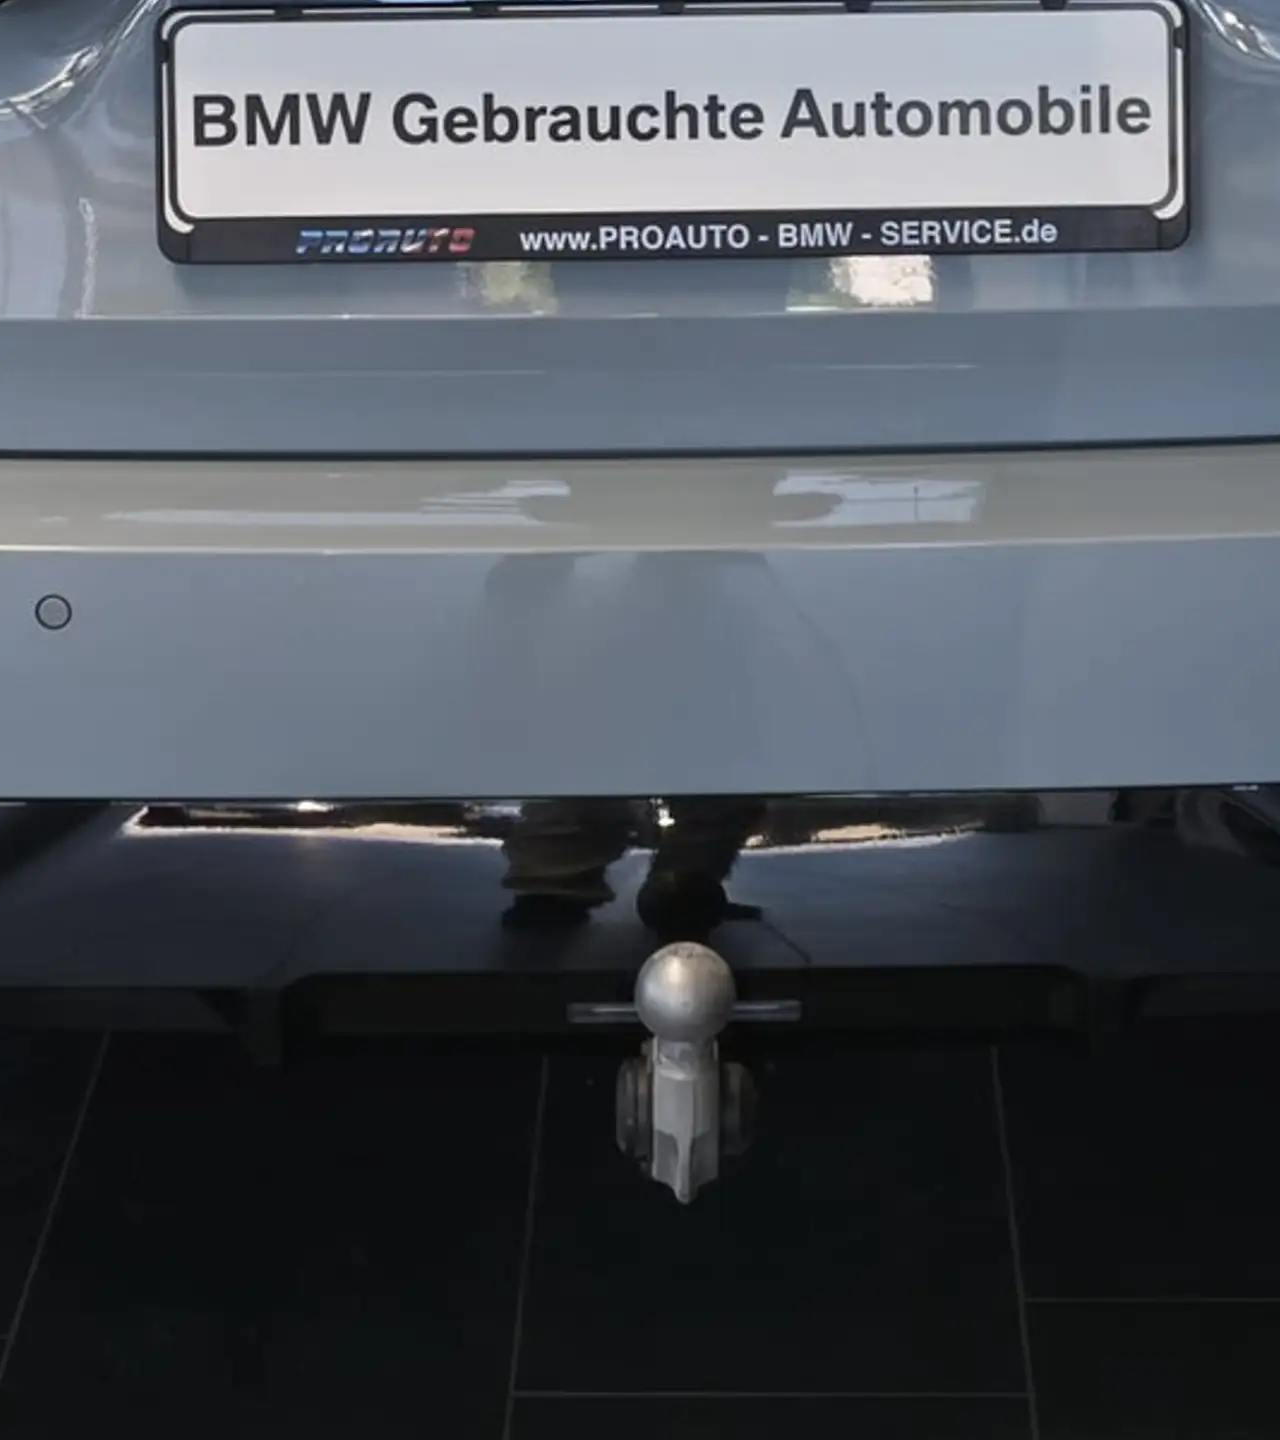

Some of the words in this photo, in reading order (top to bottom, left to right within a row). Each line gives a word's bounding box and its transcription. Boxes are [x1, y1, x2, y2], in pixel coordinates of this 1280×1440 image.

[192, 92, 372, 147] BMW
[392, 90, 765, 144] Gebrauchte
[780, 84, 1152, 139] Automobile
[295, 227, 476, 254] PROAUTO
[520, 224, 749, 251] www.PROAUTO
[777, 222, 853, 248] BMW
[880, 218, 1058, 245] SERVICE.de
